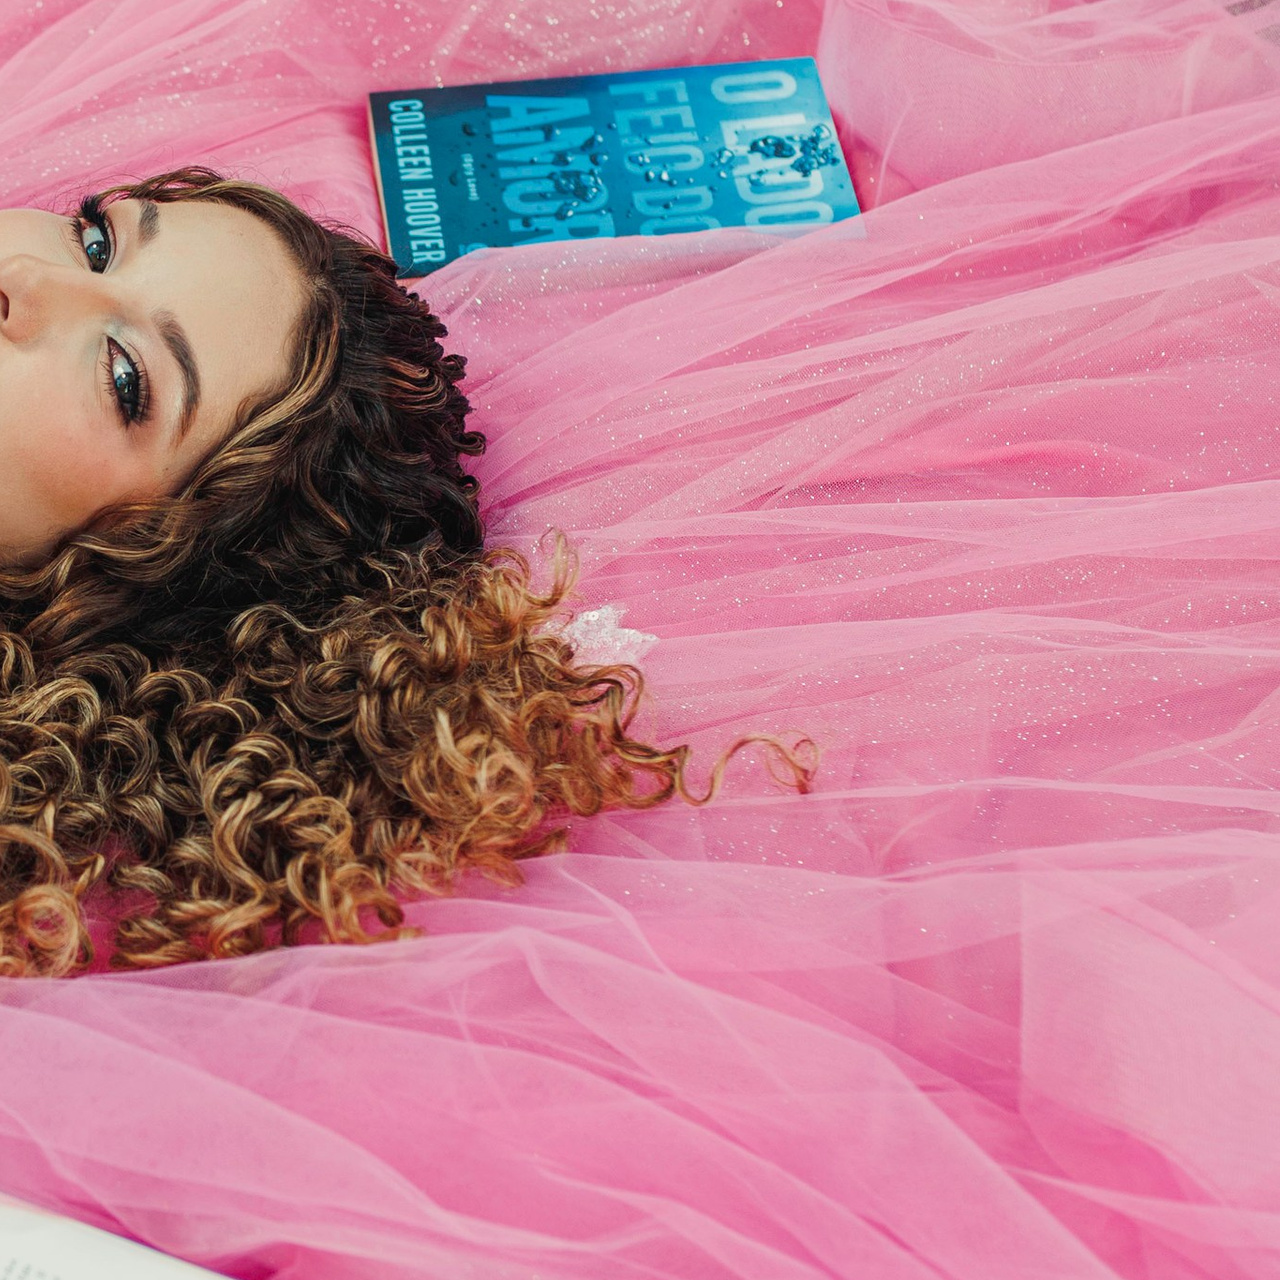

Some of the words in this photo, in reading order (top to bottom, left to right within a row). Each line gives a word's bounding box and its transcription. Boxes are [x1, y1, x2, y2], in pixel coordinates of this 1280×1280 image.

[608, 78, 706, 175] FEIO
[710, 71, 798, 104] O
[388, 99, 435, 181] COLLEEN
[485, 95, 617, 247] AMOR
[720, 113, 835, 234] LADO
[402, 188, 446, 264] HOOVER
